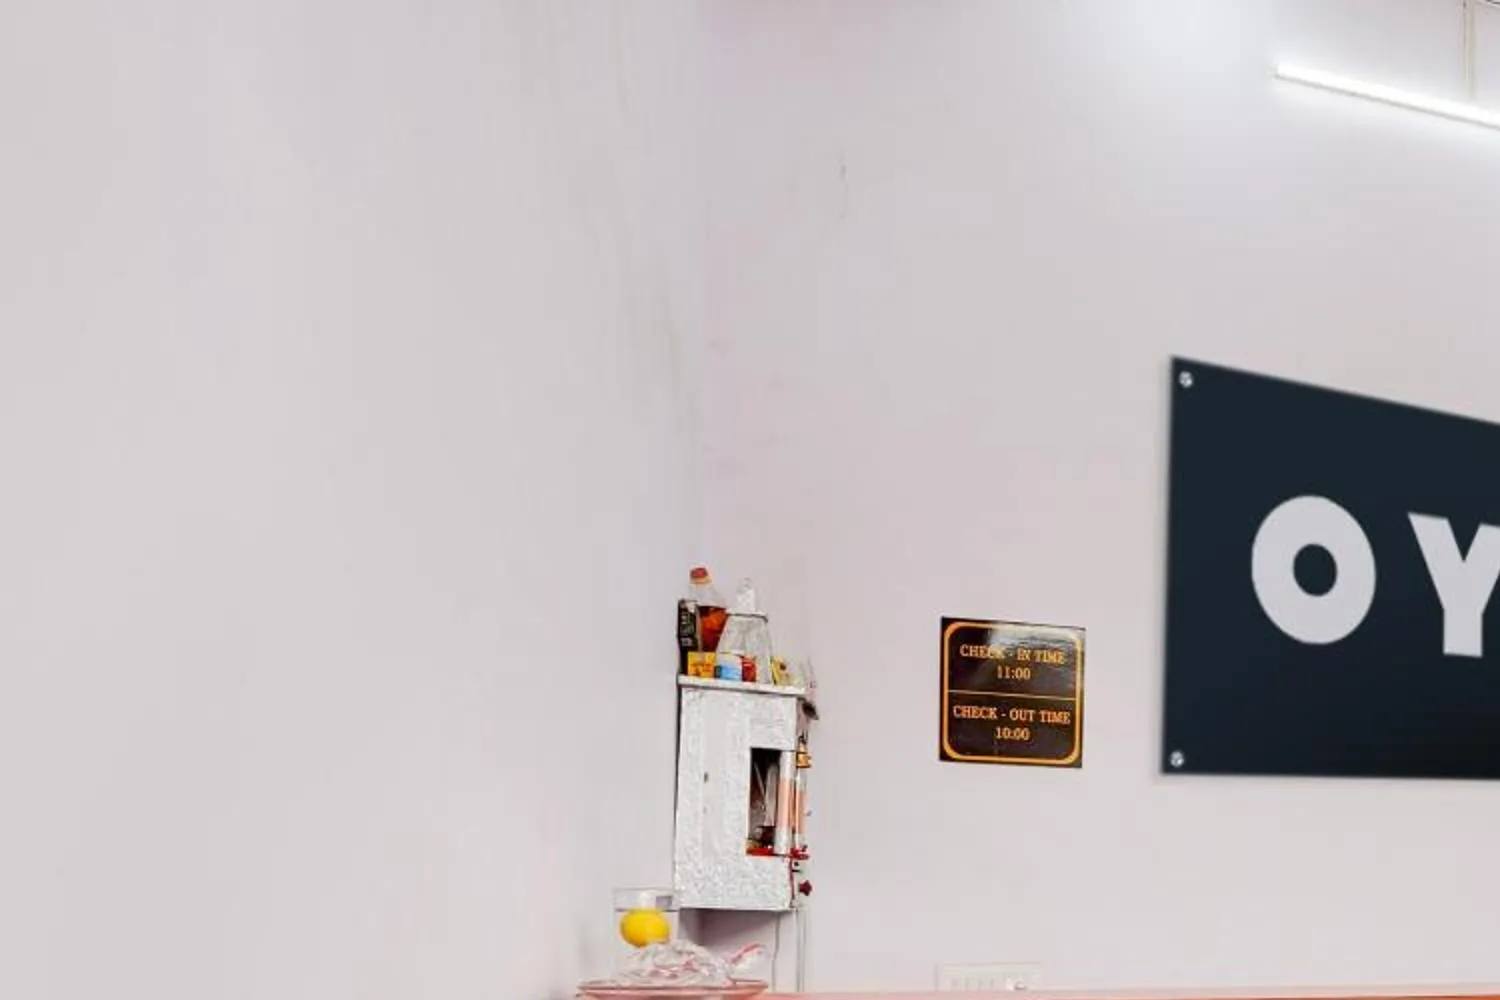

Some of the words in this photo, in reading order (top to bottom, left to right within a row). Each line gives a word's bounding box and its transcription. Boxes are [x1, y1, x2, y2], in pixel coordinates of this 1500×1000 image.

[960, 644, 1005, 660] CHECK
[1017, 647, 1031, 661] IN
[1034, 649, 1066, 665] TIME
[997, 666, 1031, 680] 11:00
[953, 705, 998, 720] CHECK
[1009, 708, 1035, 722] OUT
[1039, 710, 1071, 725] TIME
[995, 727, 1030, 741] 10:00
